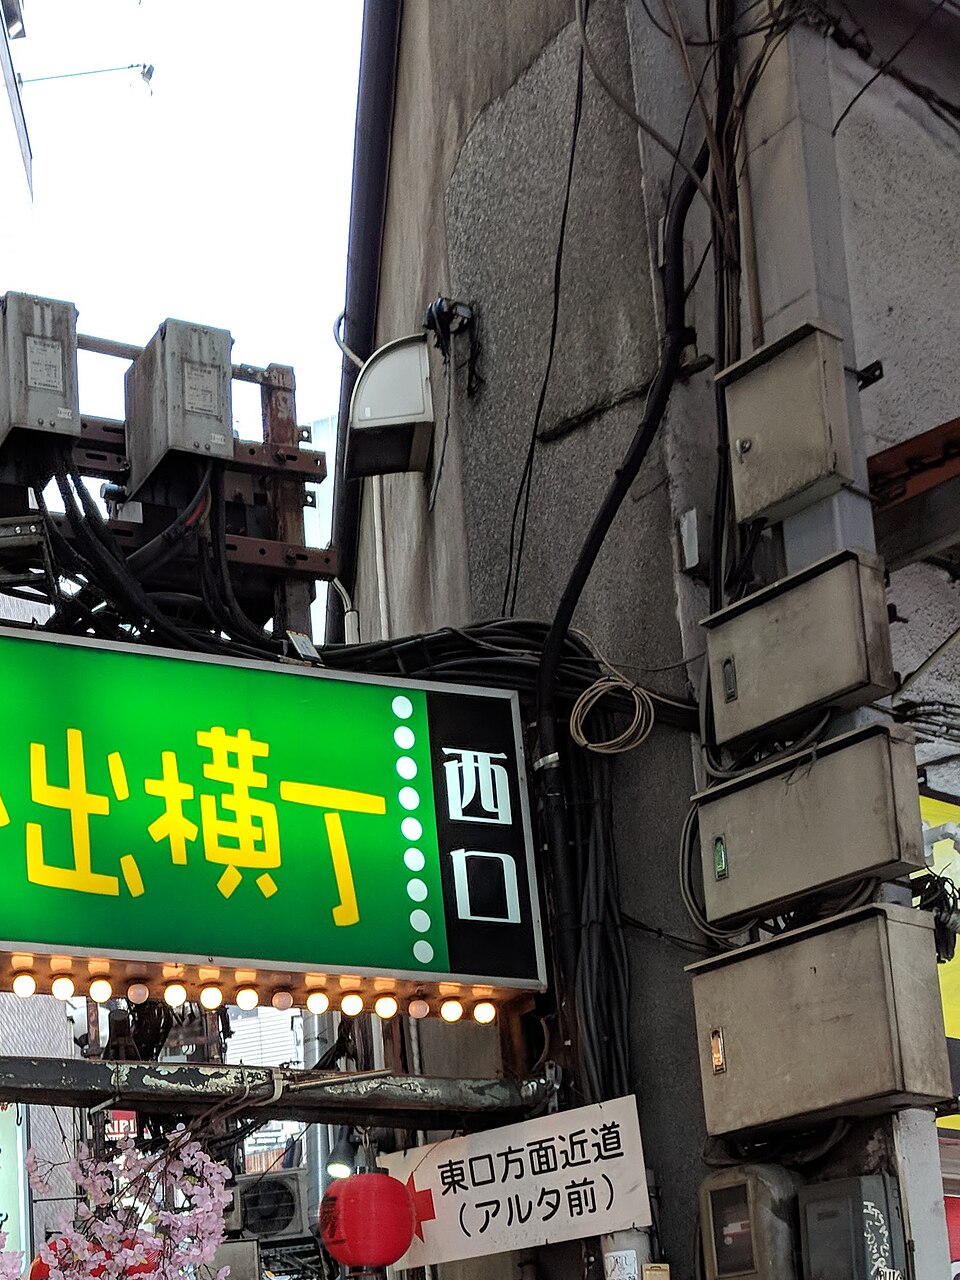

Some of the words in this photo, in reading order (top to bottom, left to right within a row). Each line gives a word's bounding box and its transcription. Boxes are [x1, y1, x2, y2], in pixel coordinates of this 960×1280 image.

[443, 746, 521, 924] 西口
[438, 1121, 624, 1196] 東口方面近道
[459, 1173, 615, 1238] (アルタ前)
